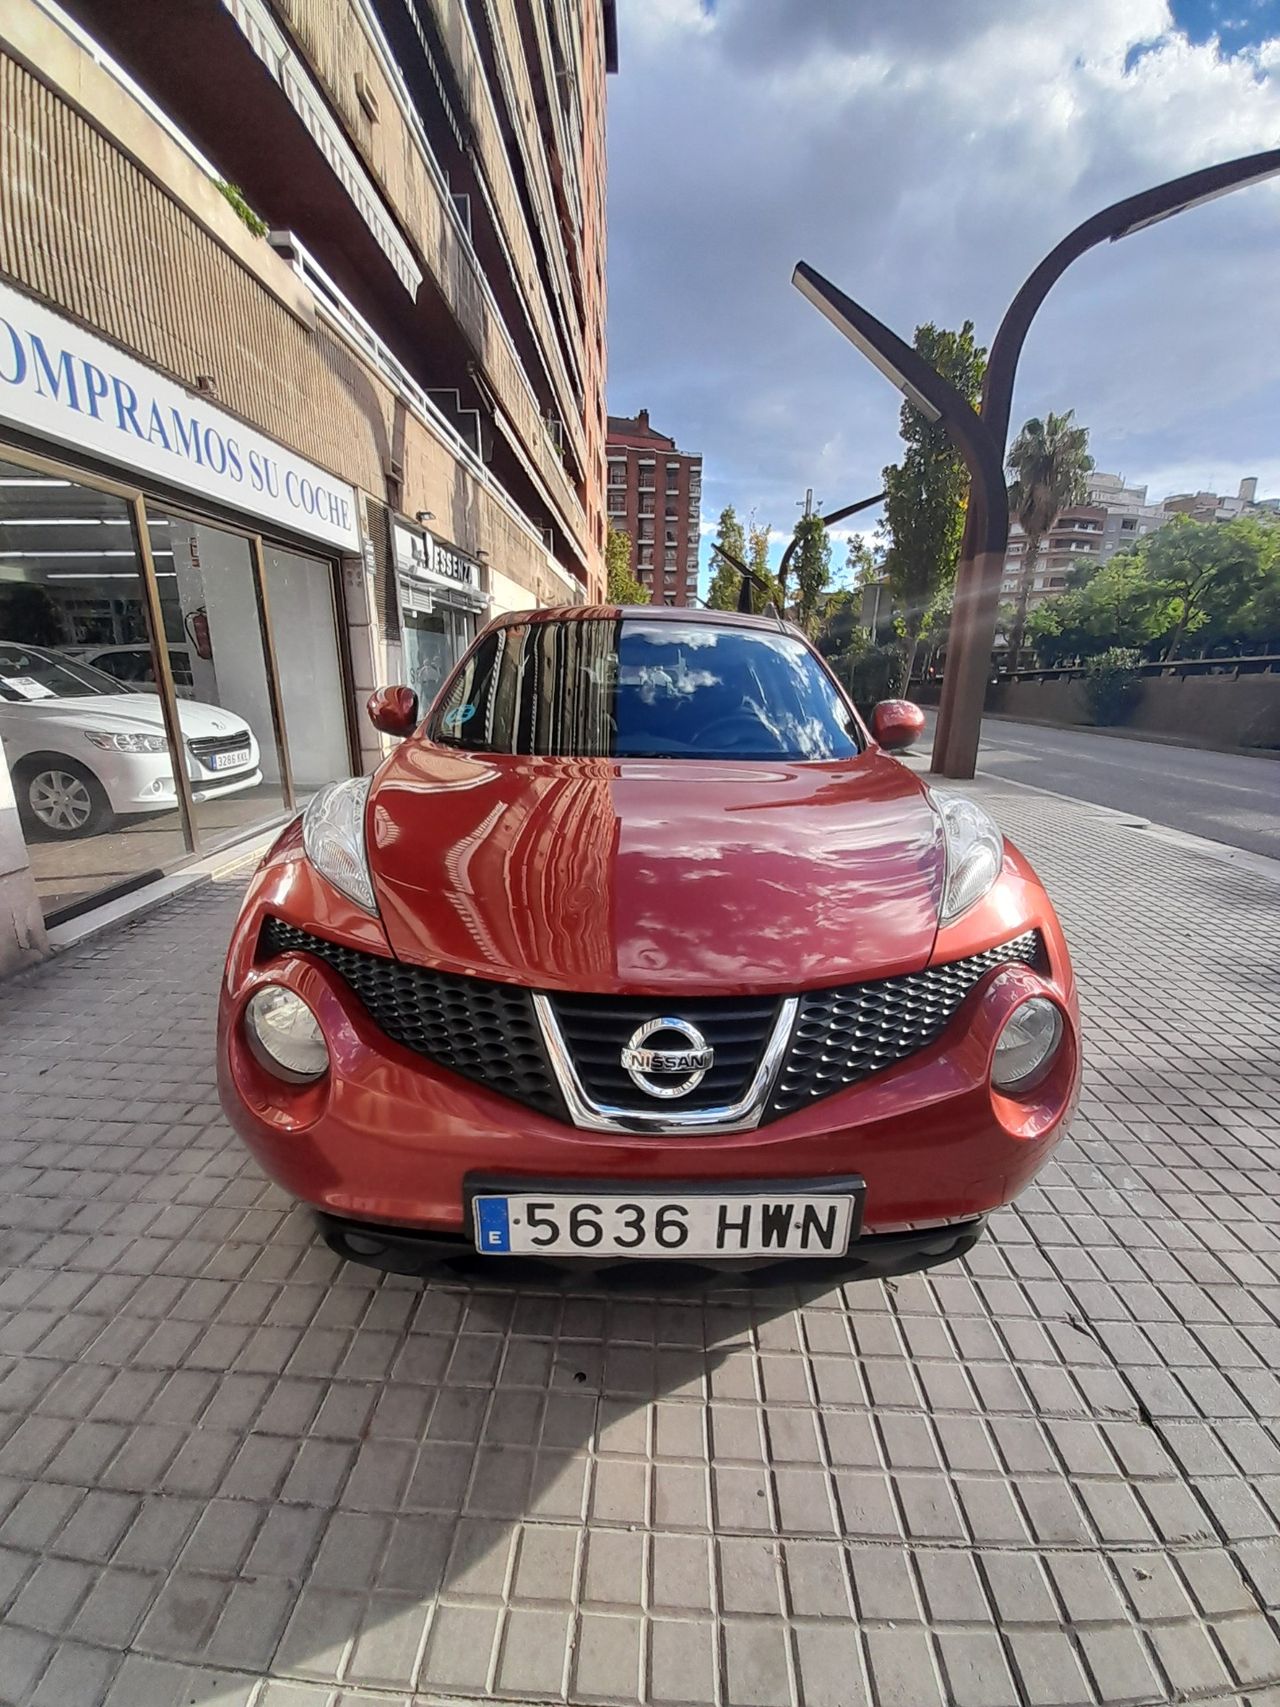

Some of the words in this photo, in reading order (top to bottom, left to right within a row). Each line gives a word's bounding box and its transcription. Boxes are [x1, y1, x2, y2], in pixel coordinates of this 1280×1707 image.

[249, 450, 278, 498] SU
[286, 471, 352, 531] COCHE
[631, 1054, 705, 1069] NISSAN
[488, 1231, 502, 1244] E
[526, 1202, 690, 1249] 5636
[717, 1203, 838, 1250] HWN
